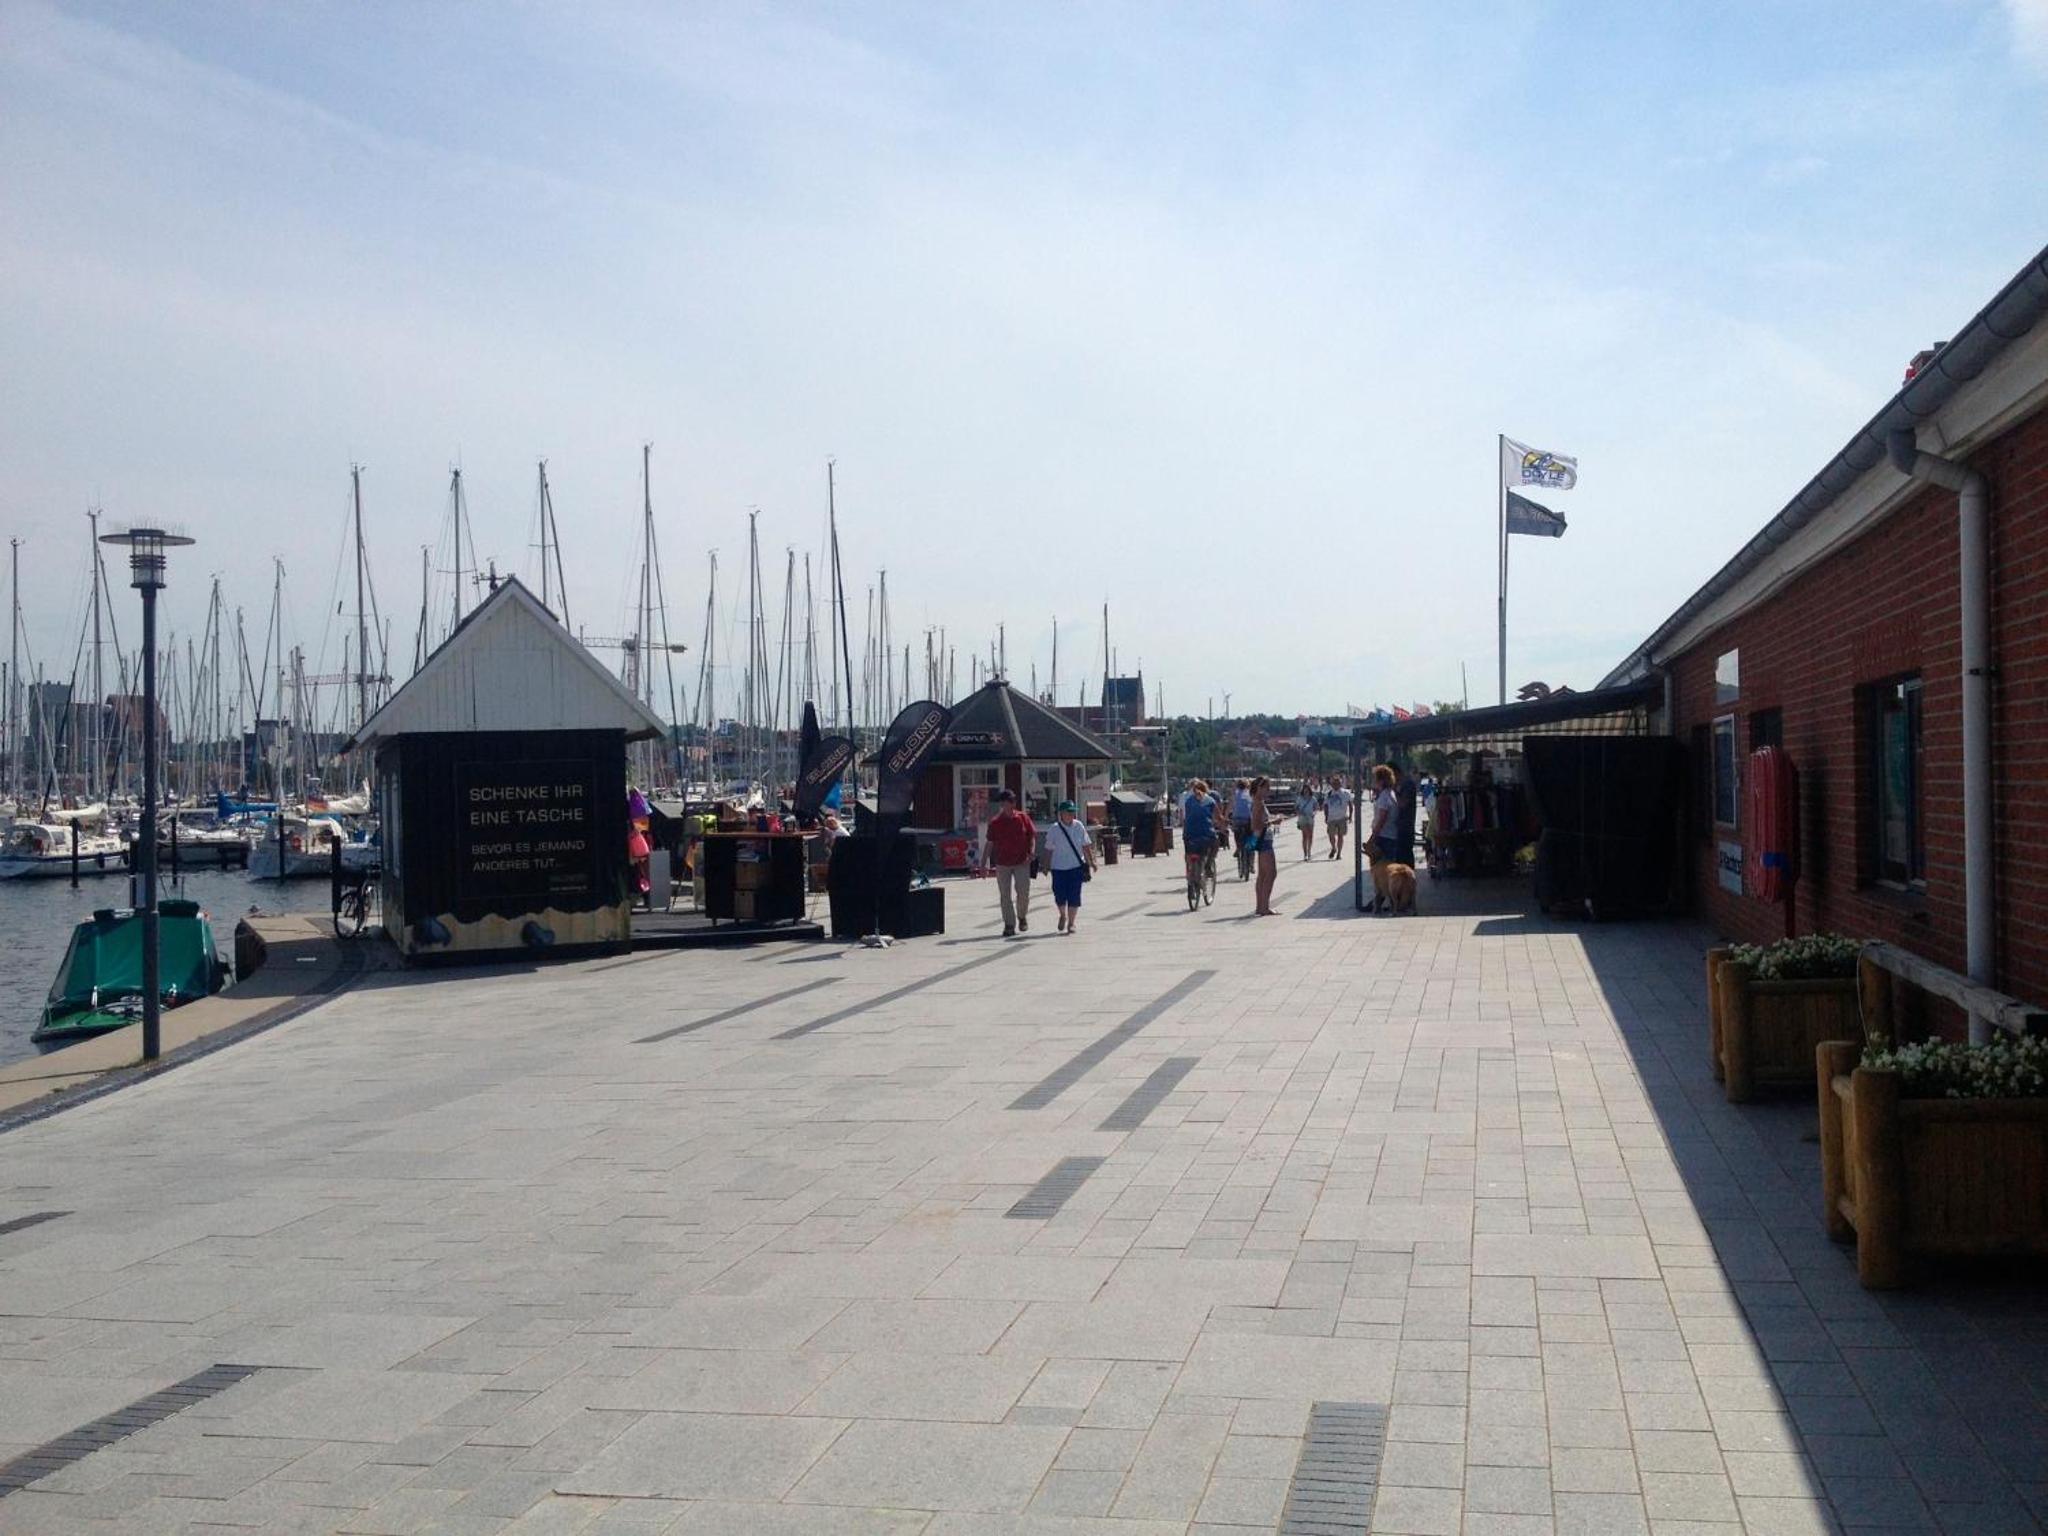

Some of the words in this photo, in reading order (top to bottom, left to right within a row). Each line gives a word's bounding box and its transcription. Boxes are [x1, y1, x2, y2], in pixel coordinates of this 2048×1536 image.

[1521, 469, 1565, 481] DOYLE
[888, 709, 942, 774] BLOND
[469, 785, 549, 801] SCHENKE
[555, 784, 583, 798] IHR
[470, 810, 510, 825] EINE
[515, 807, 584, 823] TASCHE
[471, 843, 512, 855] BEVOR
[516, 842, 530, 852] ES
[534, 840, 585, 852] JEMAND
[473, 859, 530, 872] ANDERES
